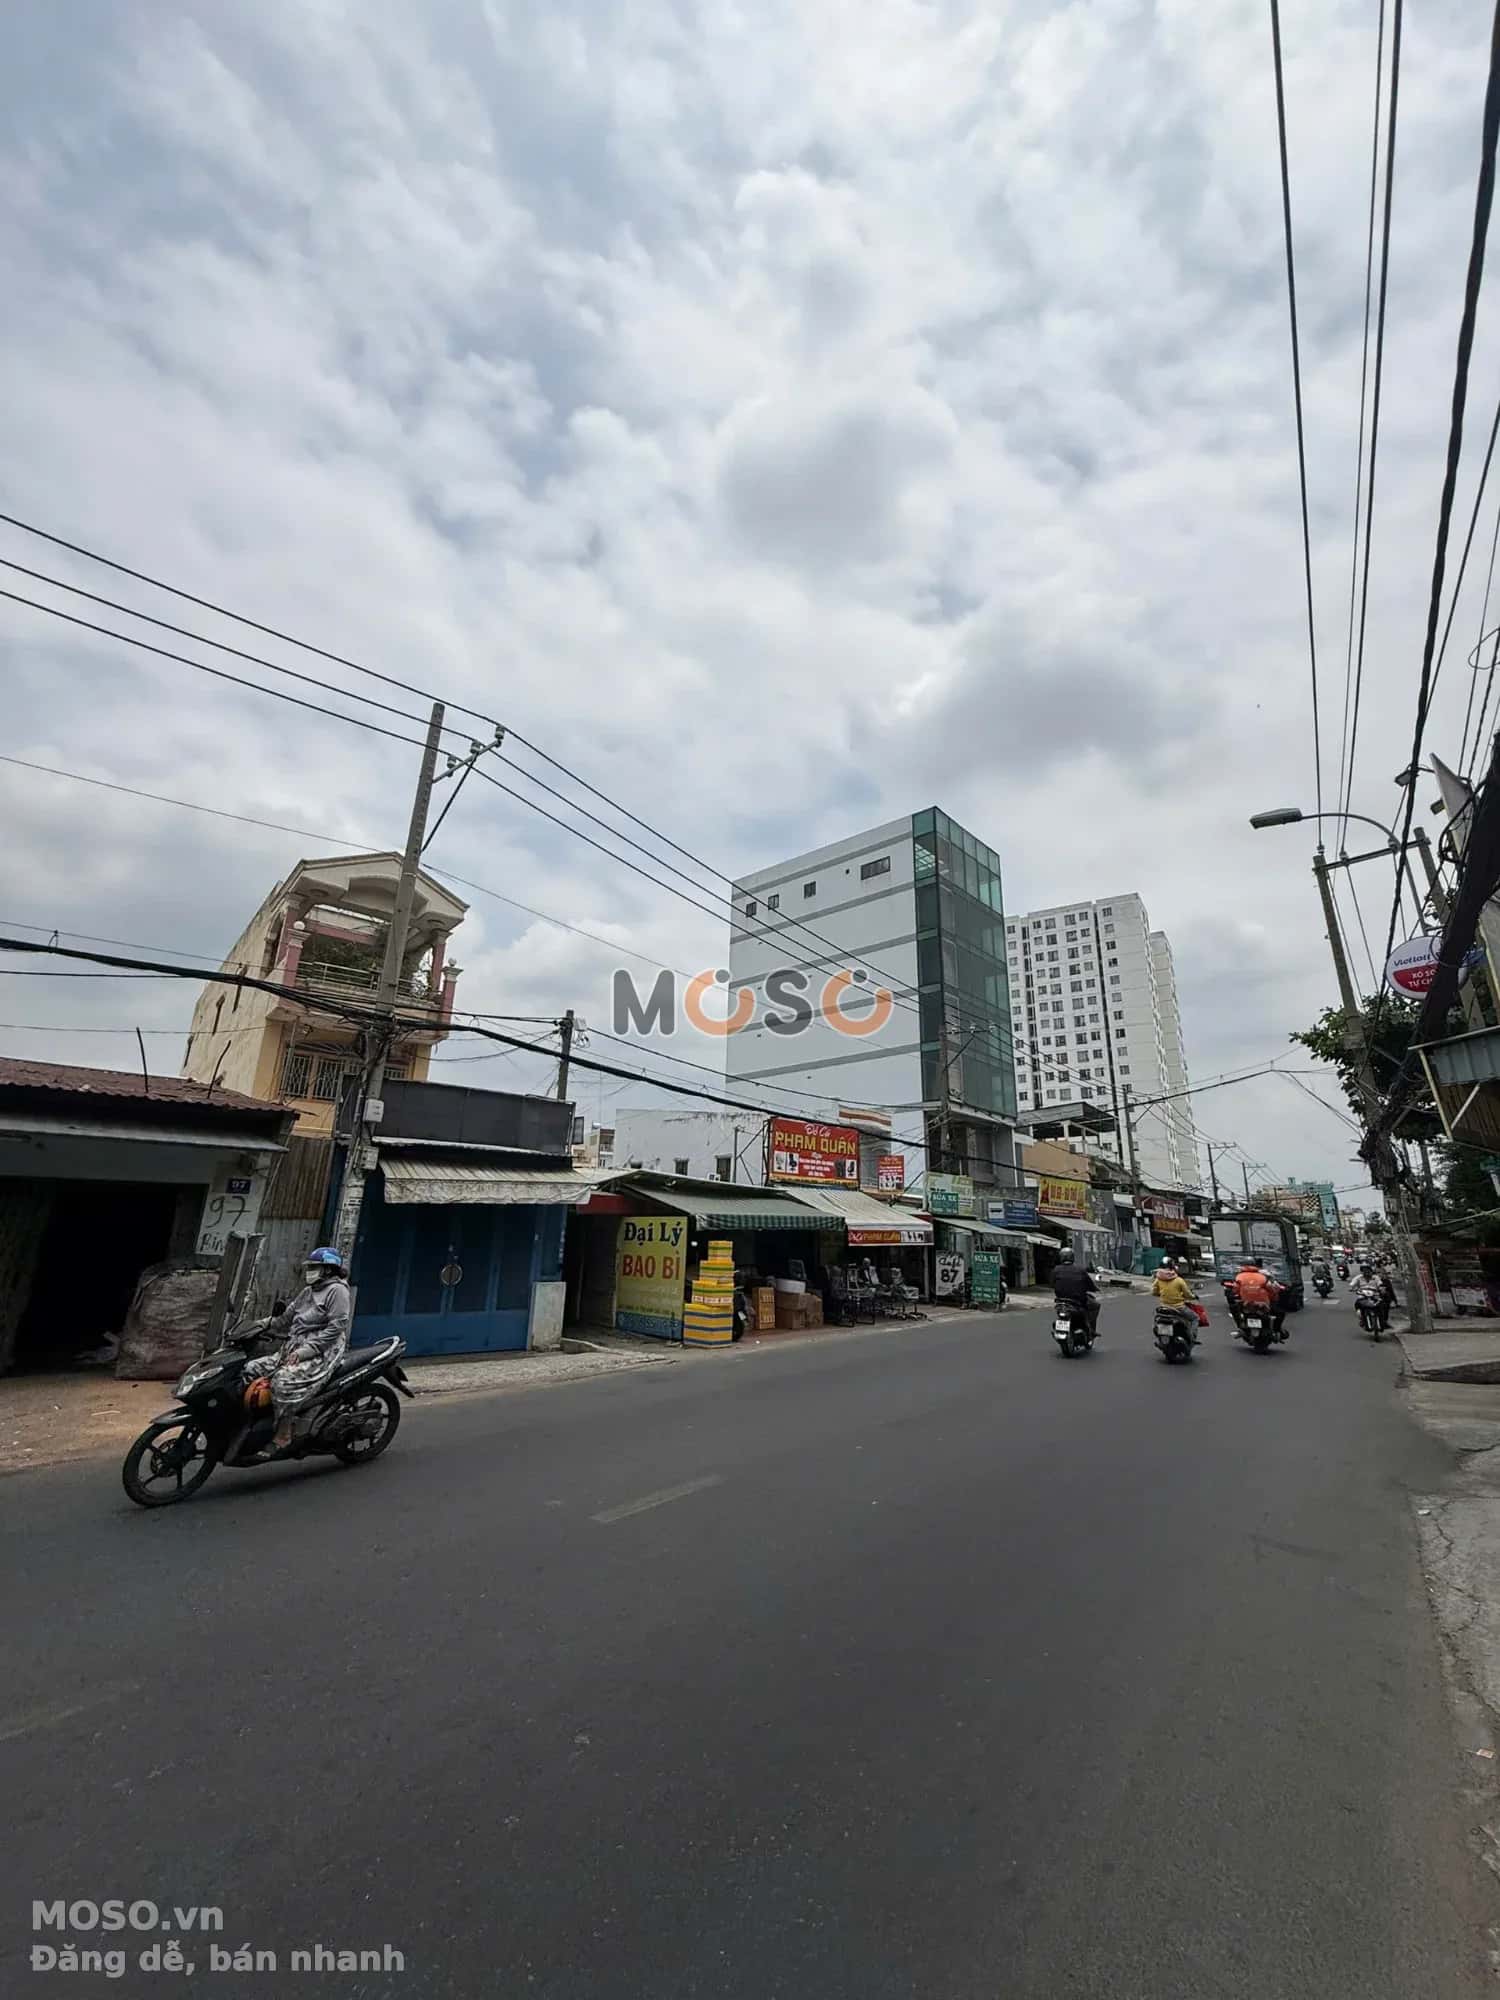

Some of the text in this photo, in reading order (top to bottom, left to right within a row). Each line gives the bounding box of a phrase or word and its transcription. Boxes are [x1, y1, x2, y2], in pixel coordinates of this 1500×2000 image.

[775, 1131, 856, 1155] PHẠM QUÂN
[206, 1195, 252, 1228] 97
[623, 1221, 683, 1247] Đại Lý
[622, 1254, 657, 1279] BAO
[940, 1269, 960, 1283] 87
